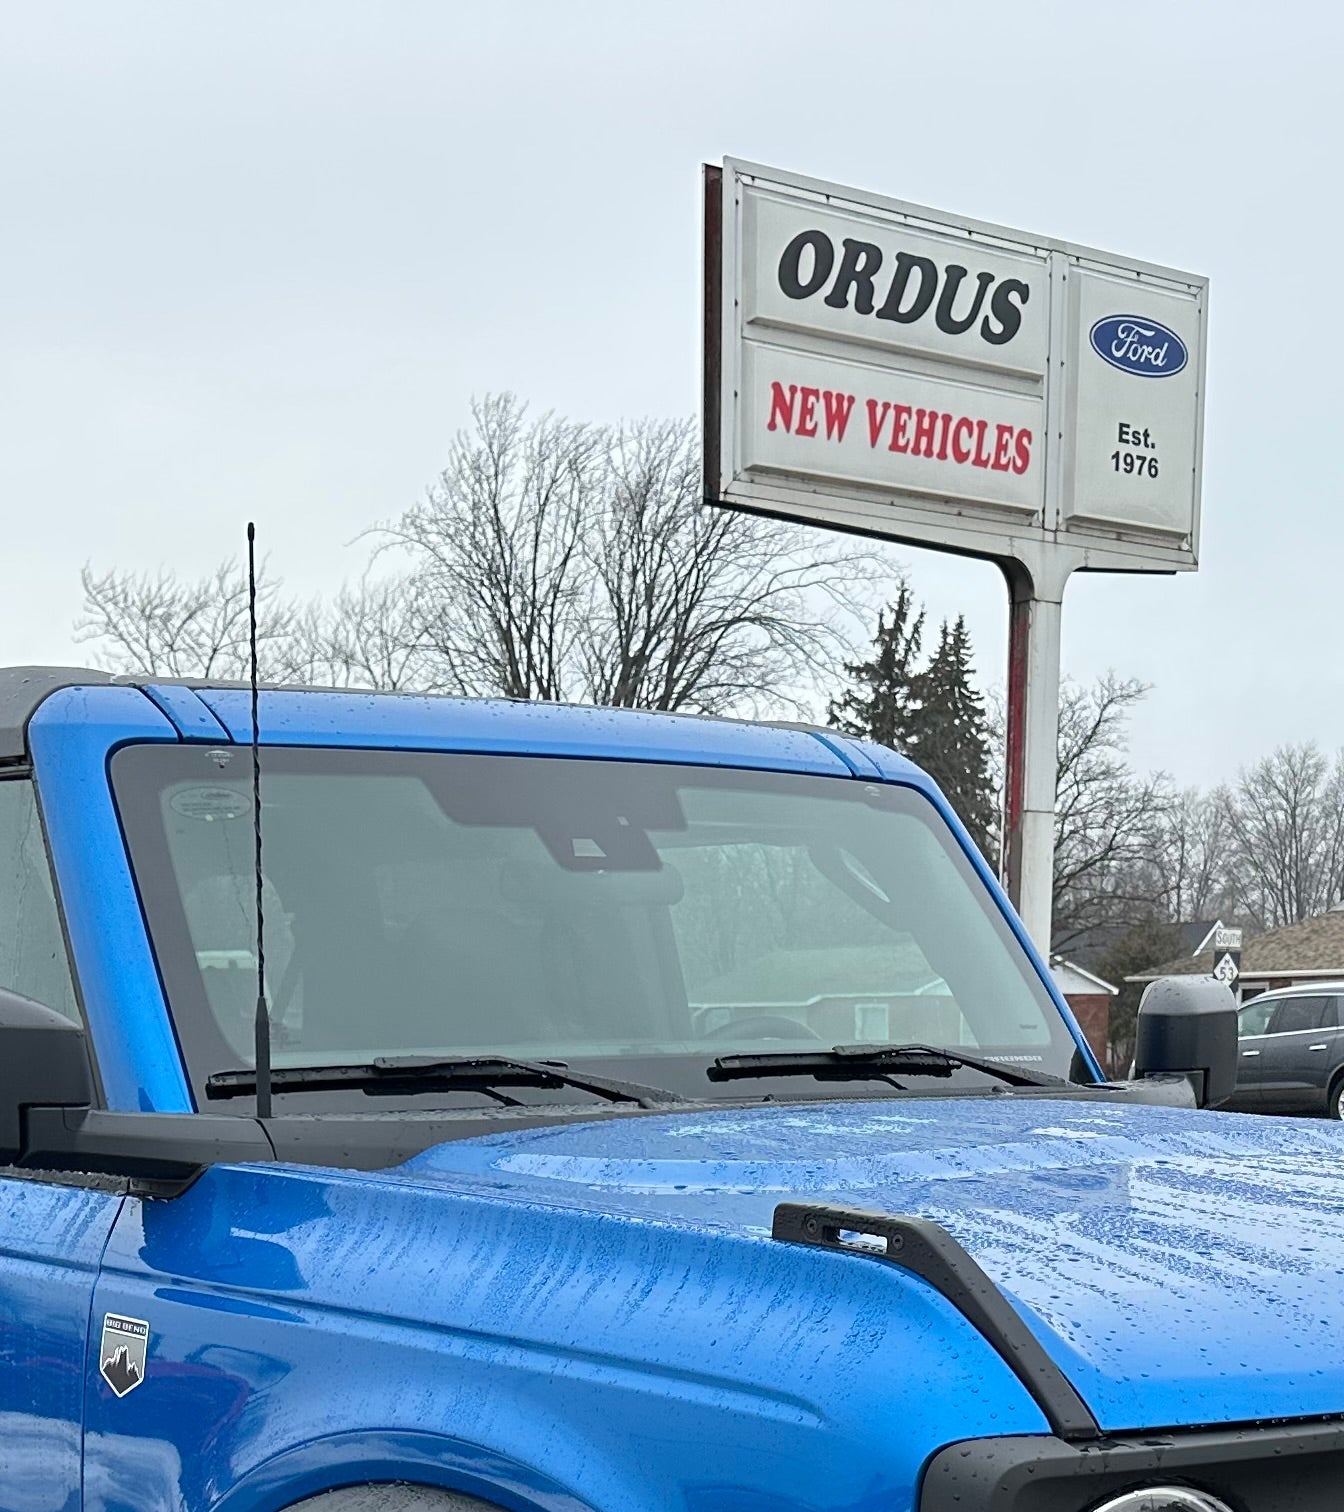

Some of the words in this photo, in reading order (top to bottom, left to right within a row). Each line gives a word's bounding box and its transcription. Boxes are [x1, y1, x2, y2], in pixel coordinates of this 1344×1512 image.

[778, 229, 1031, 346] ORDUS
[1111, 323, 1169, 367] Ford
[767, 381, 856, 444] NEW
[866, 398, 1034, 476] VEHICLES
[1118, 422, 1157, 450] Est.
[1111, 450, 1160, 479] 1976
[1217, 930, 1241, 945] SOUTH
[1219, 966, 1234, 981] 53
